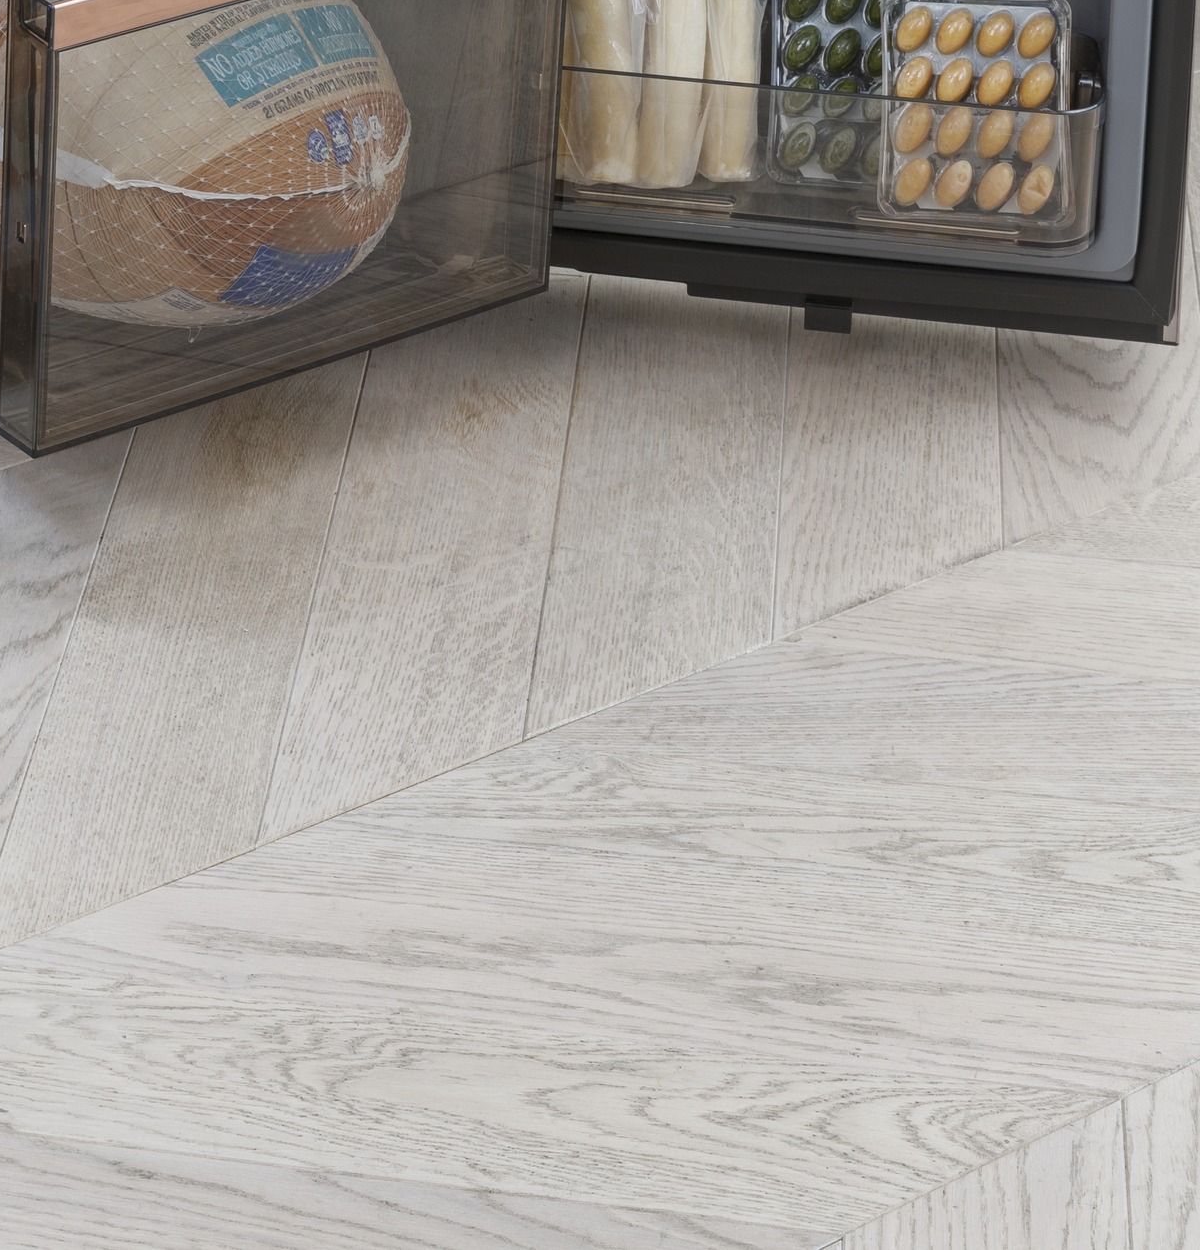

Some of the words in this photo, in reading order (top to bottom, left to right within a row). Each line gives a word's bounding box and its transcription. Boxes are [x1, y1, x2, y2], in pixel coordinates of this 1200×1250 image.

[186, 23, 211, 42] BASTED
[190, 32, 212, 49] SUGAR
[217, 13, 245, 34] NATURAL
[203, 53, 234, 80] NO
[231, 41, 262, 69] ADDED
[261, 29, 302, 58] HORMONES
[236, 72, 254, 91] OR
[262, 105, 275, 119] 21
[274, 91, 304, 114] GRAMS
